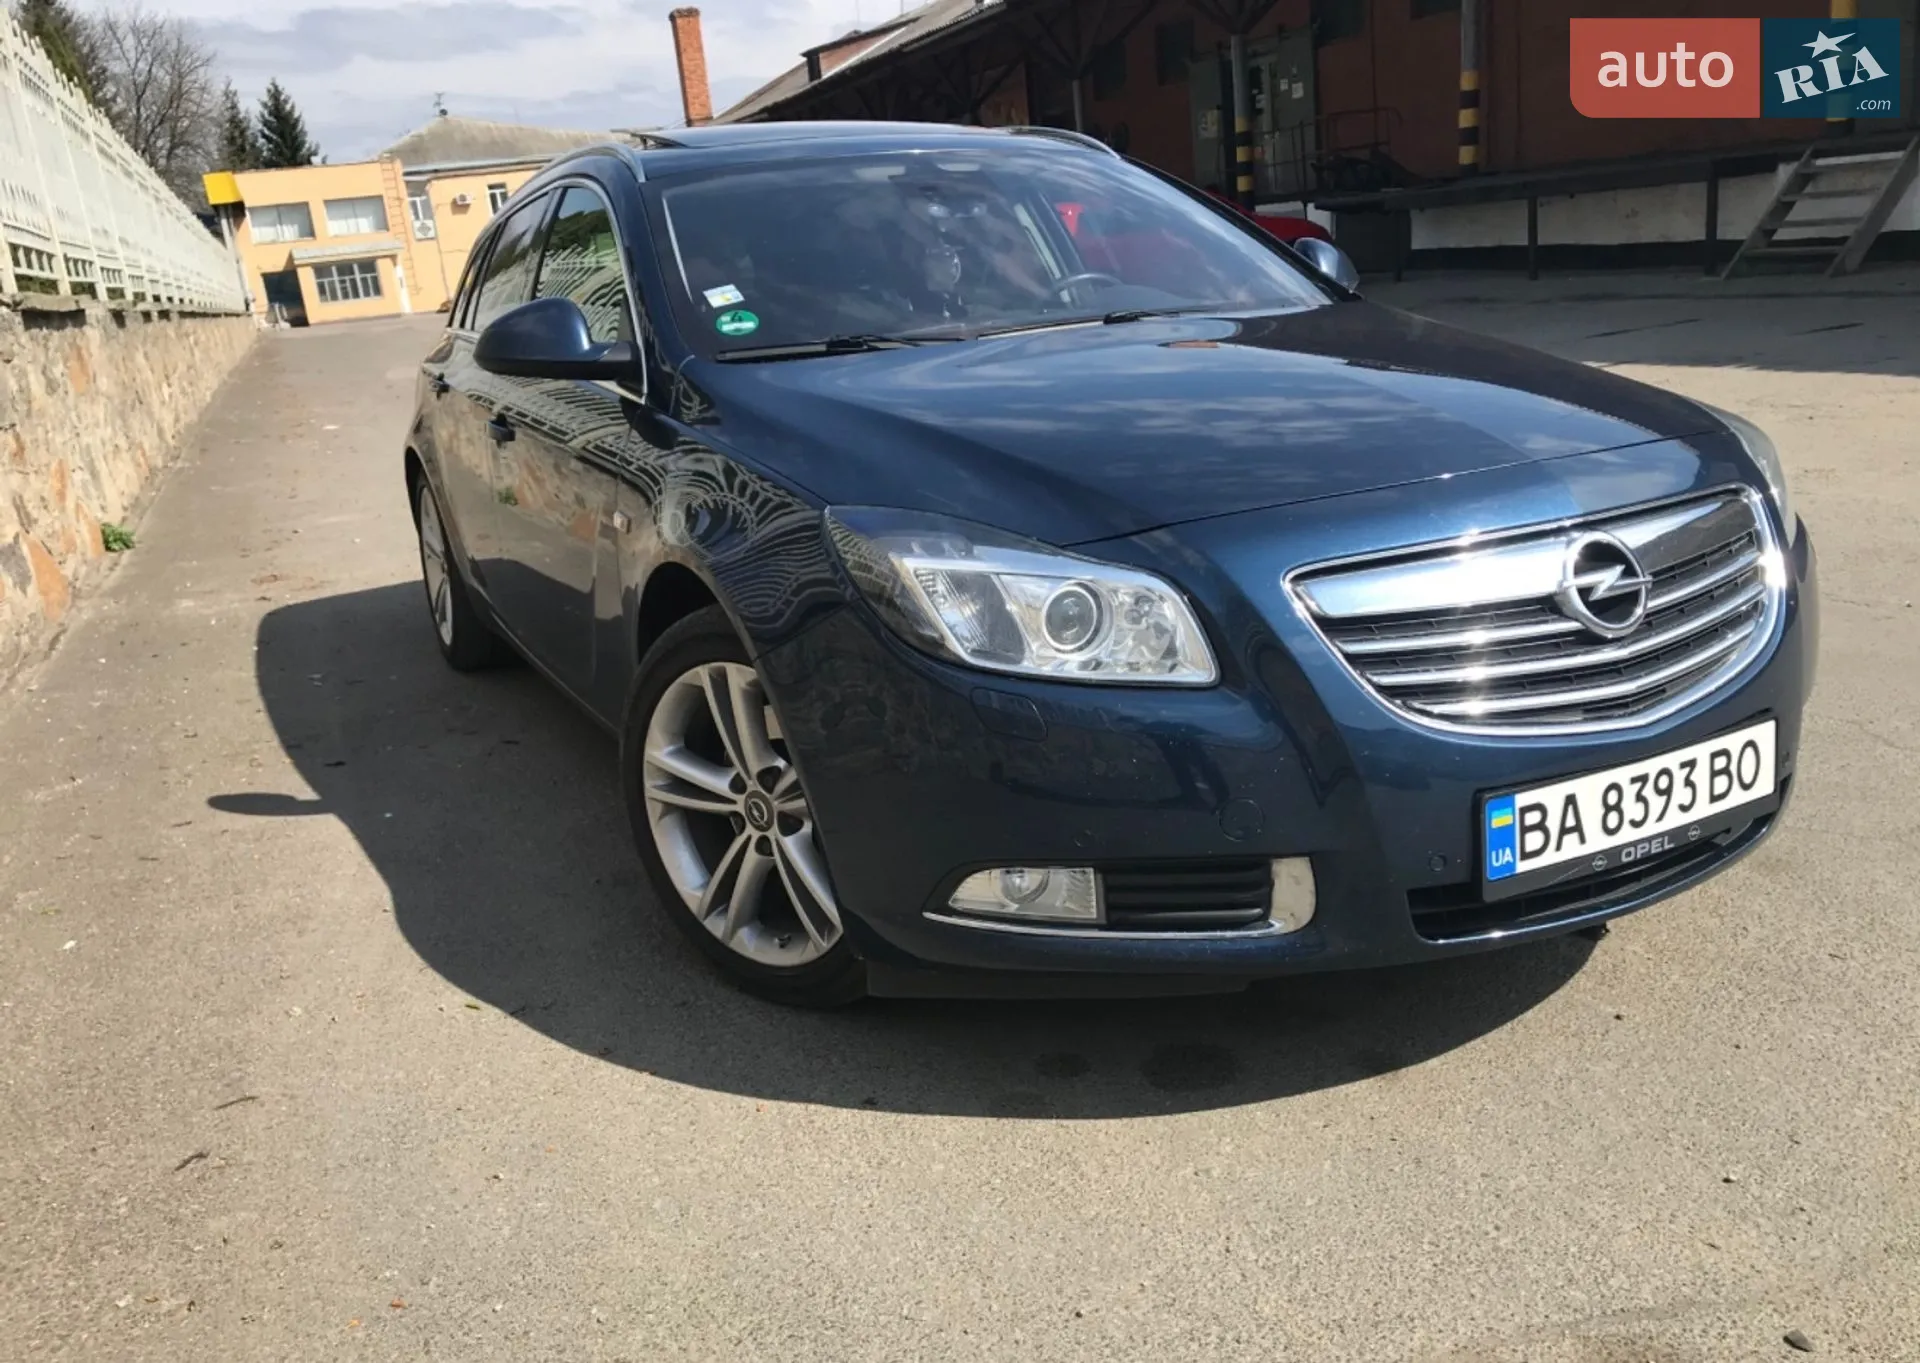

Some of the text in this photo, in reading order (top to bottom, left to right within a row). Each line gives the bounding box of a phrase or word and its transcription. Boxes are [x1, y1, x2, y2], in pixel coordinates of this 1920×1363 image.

[1518, 739, 1761, 862] BA 8393 BO
[1491, 848, 1514, 867] UA
[1620, 836, 1675, 863] OPEL
